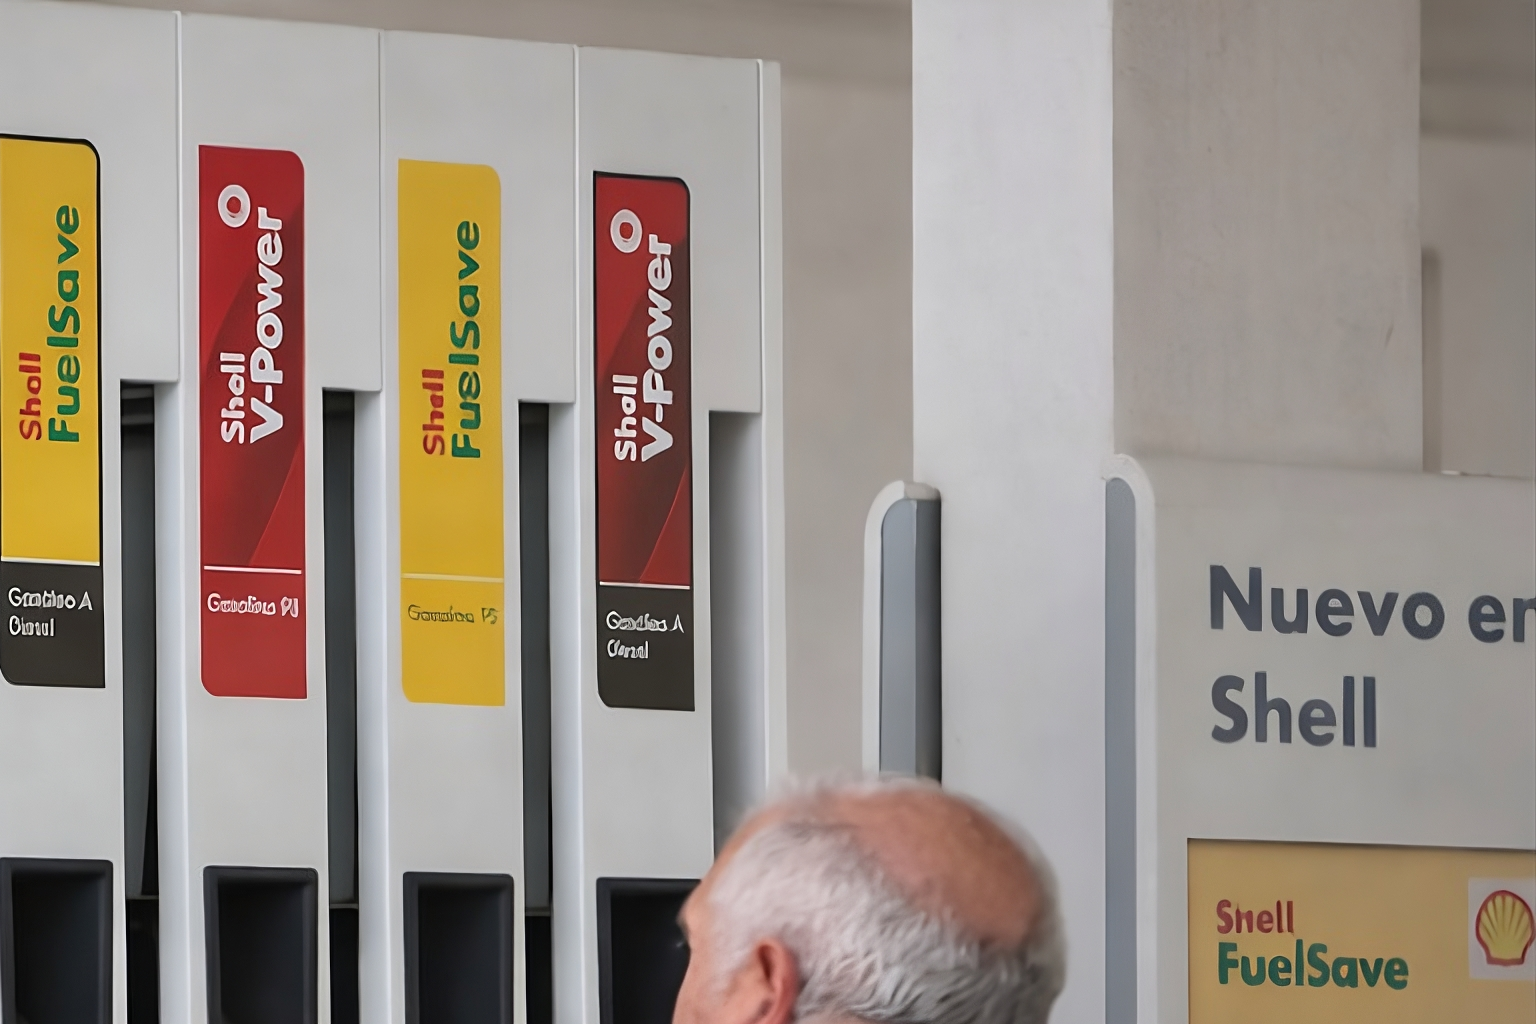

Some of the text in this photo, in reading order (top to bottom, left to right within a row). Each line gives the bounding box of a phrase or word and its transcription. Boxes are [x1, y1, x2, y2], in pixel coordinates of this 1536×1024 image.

[46, 205, 82, 443] FuelSave
[249, 206, 284, 445] V-Power
[448, 220, 482, 459] FuelSave
[641, 233, 674, 463] V-Power
[1209, 564, 1446, 641] Nuevo
[1210, 670, 1378, 749] Shell
[1217, 938, 1410, 990] FuelSave
